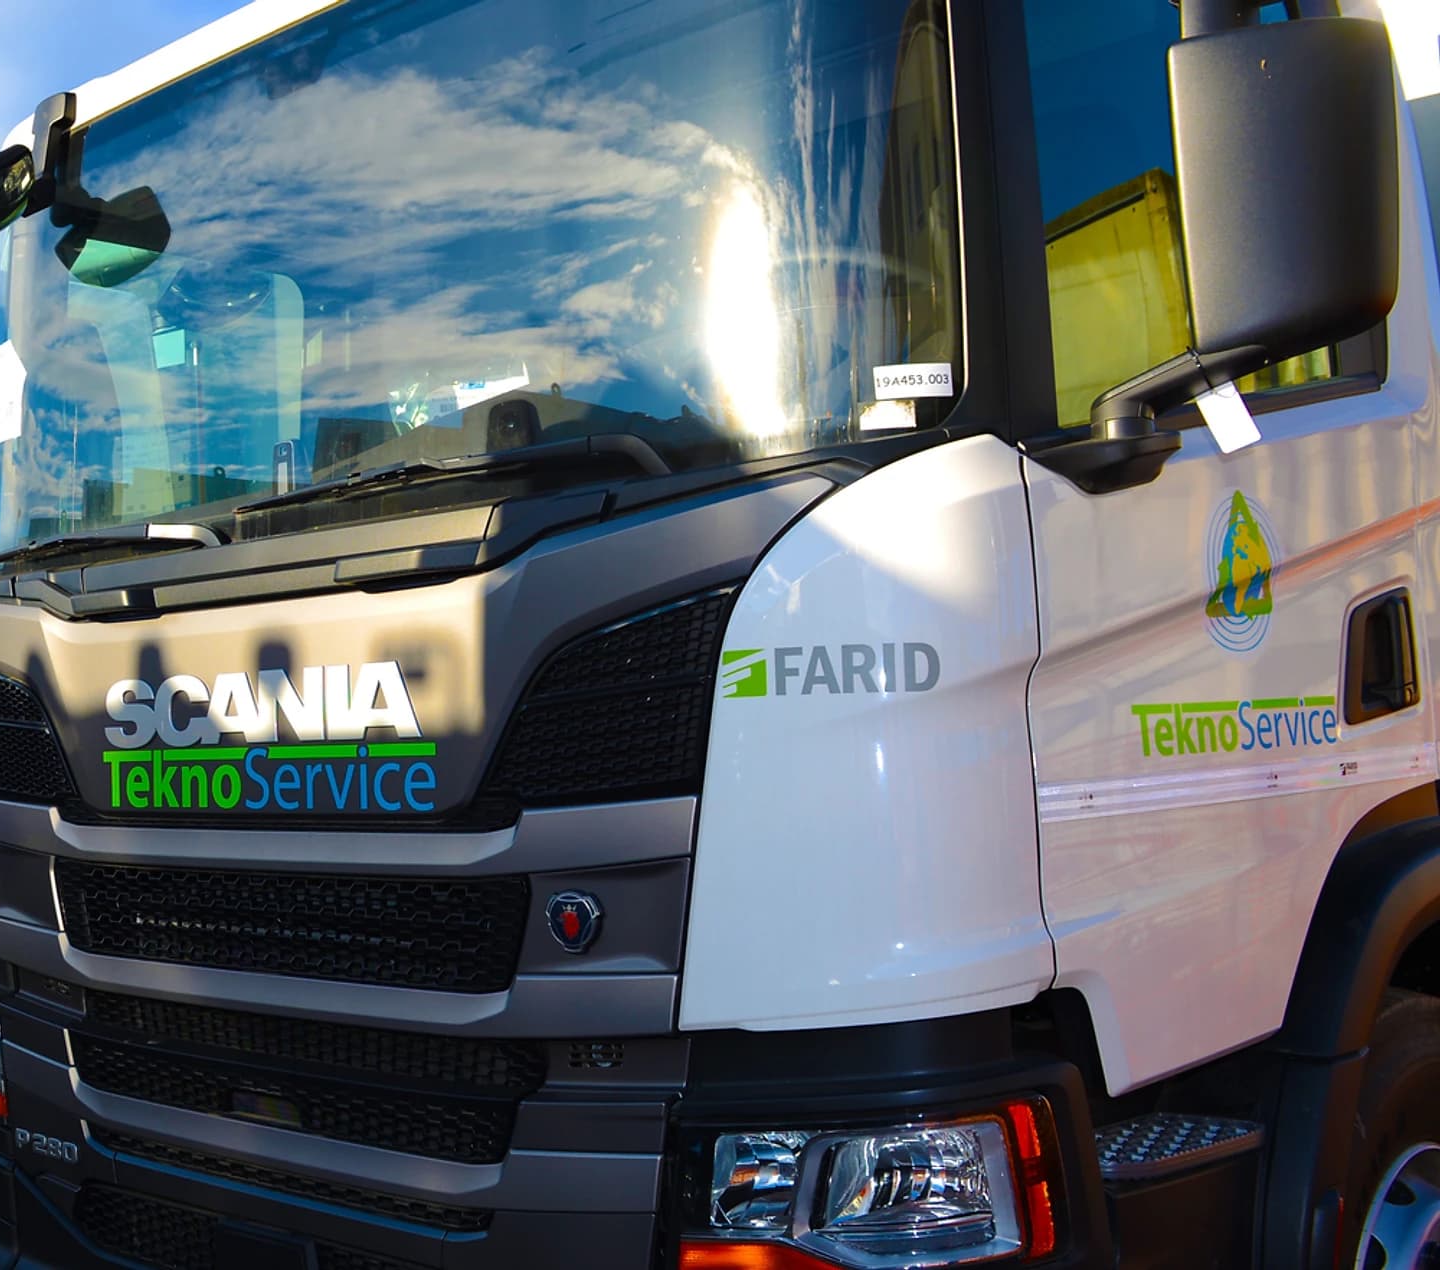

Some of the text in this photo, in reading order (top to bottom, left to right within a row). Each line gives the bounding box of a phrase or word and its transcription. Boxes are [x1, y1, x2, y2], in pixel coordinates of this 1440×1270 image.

[875, 373, 950, 388] 19A453.003
[773, 641, 942, 696] FARID
[103, 658, 424, 749] SCANIA
[1130, 695, 1338, 758] TeknoService
[102, 742, 437, 812] TeknoService
[15, 1127, 30, 1149] P
